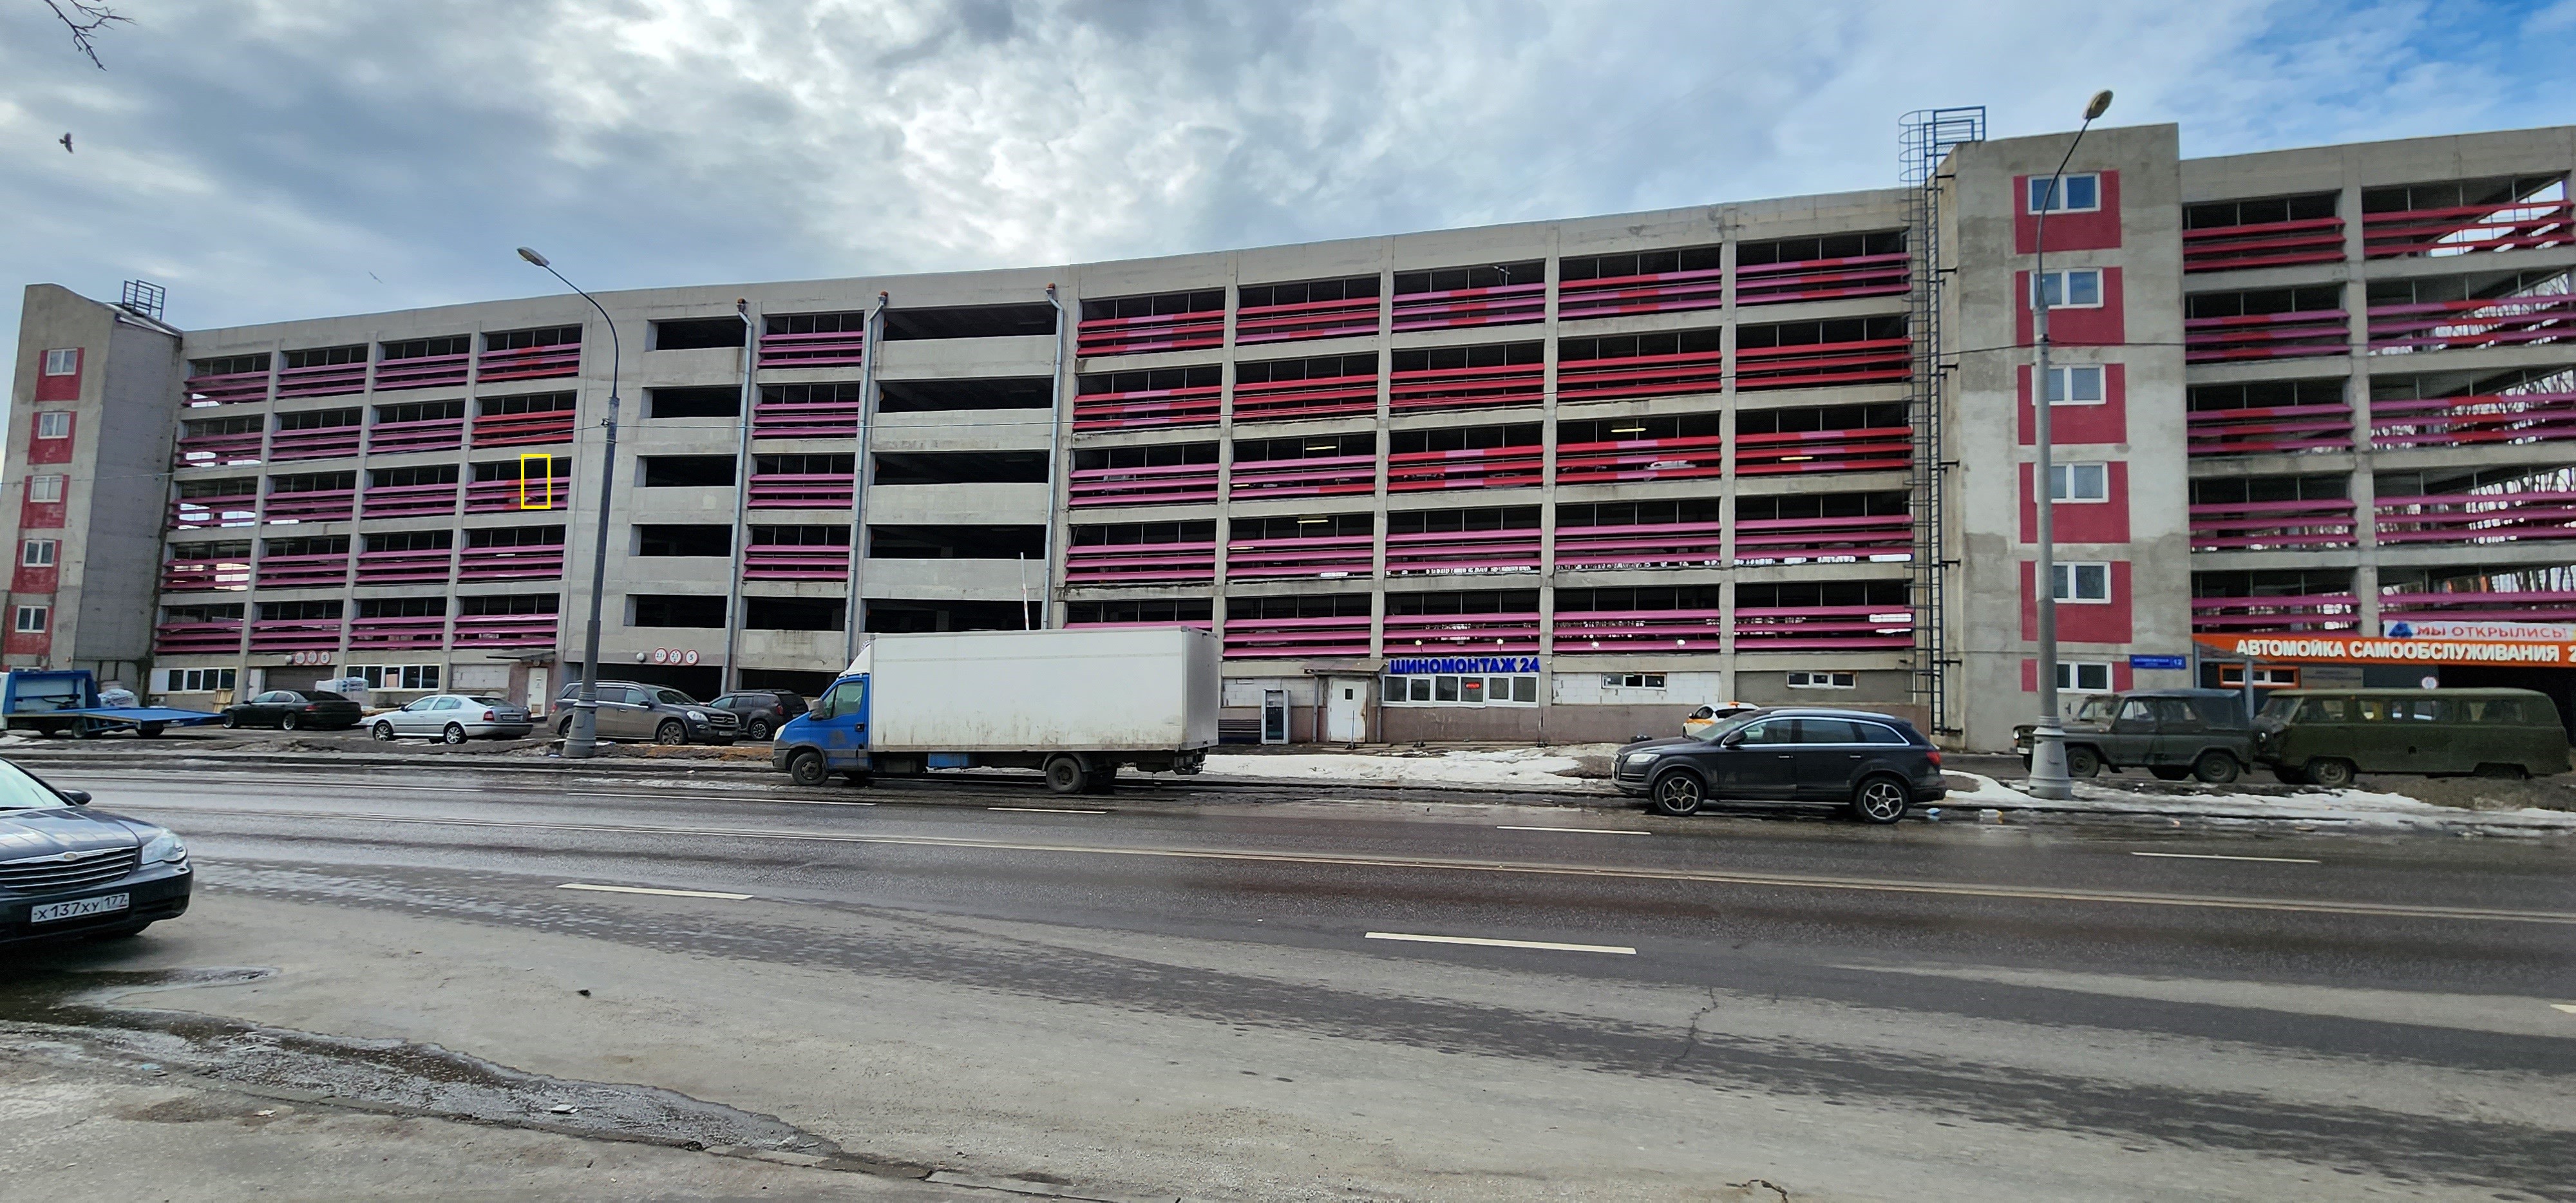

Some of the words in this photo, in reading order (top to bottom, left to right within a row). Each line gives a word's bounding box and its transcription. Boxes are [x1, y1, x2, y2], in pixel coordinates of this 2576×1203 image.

[2417, 625, 2446, 636] МЫ
[2236, 639, 2346, 657] АВТОМОЙКА
[2349, 641, 2559, 663] САМООБСЛУЖИВАНИЯ
[1390, 658, 1517, 674] ШИНОМОНТАЖ
[1520, 657, 1540, 672] 24
[104, 895, 126, 905] 177
